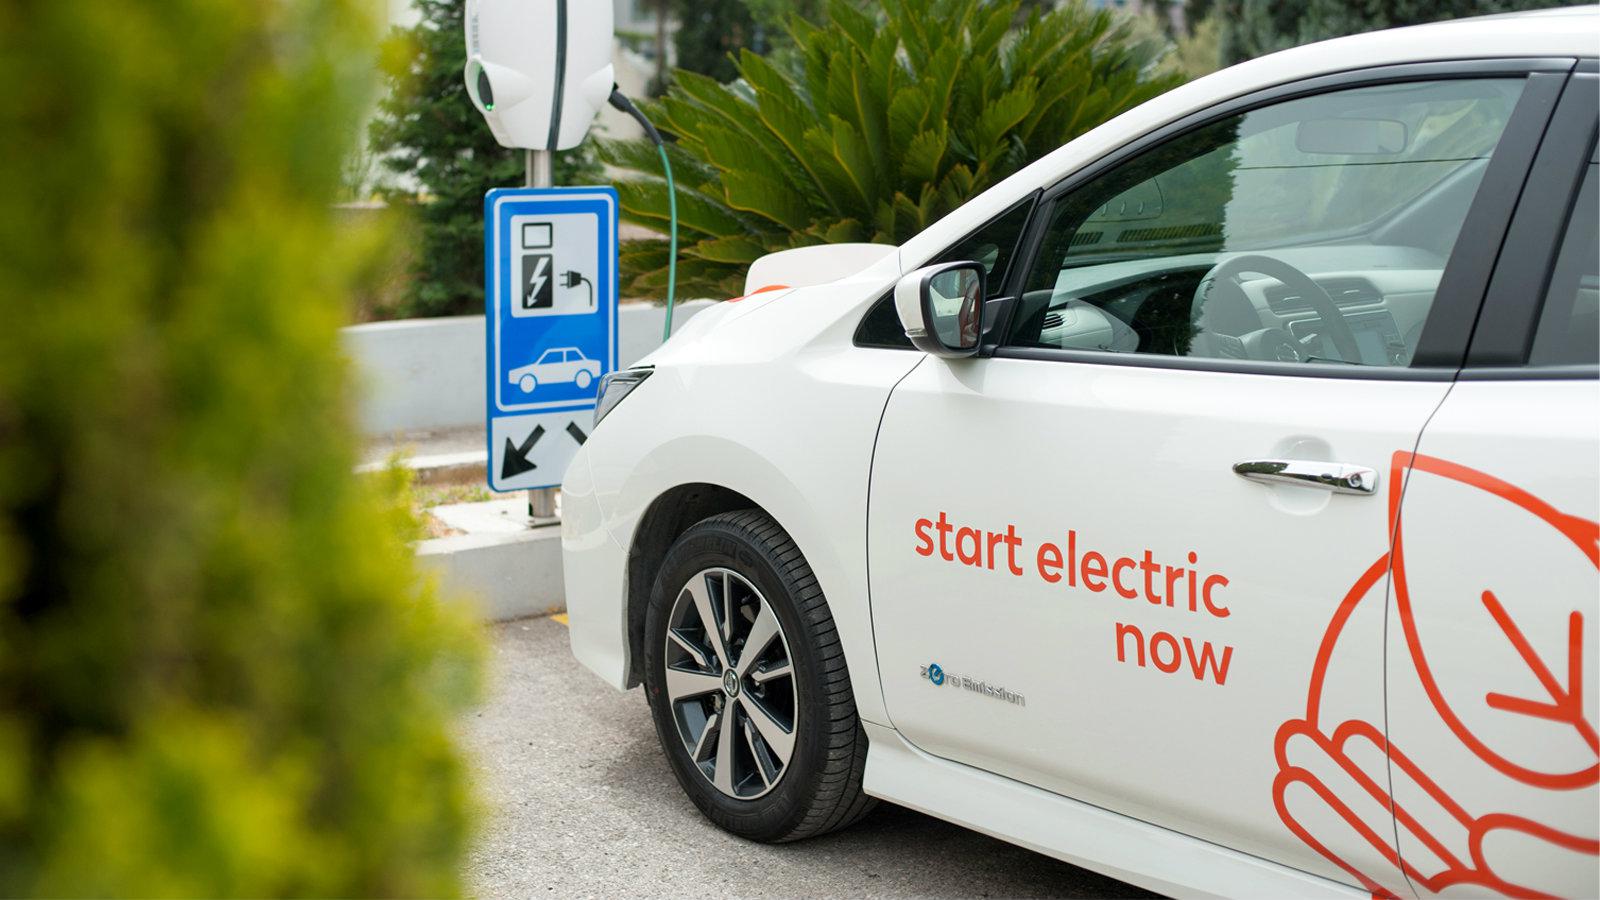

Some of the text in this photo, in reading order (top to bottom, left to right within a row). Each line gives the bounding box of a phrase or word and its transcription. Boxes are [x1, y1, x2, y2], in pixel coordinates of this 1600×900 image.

[914, 511, 1230, 618] start electric
[1115, 622, 1233, 685] now
